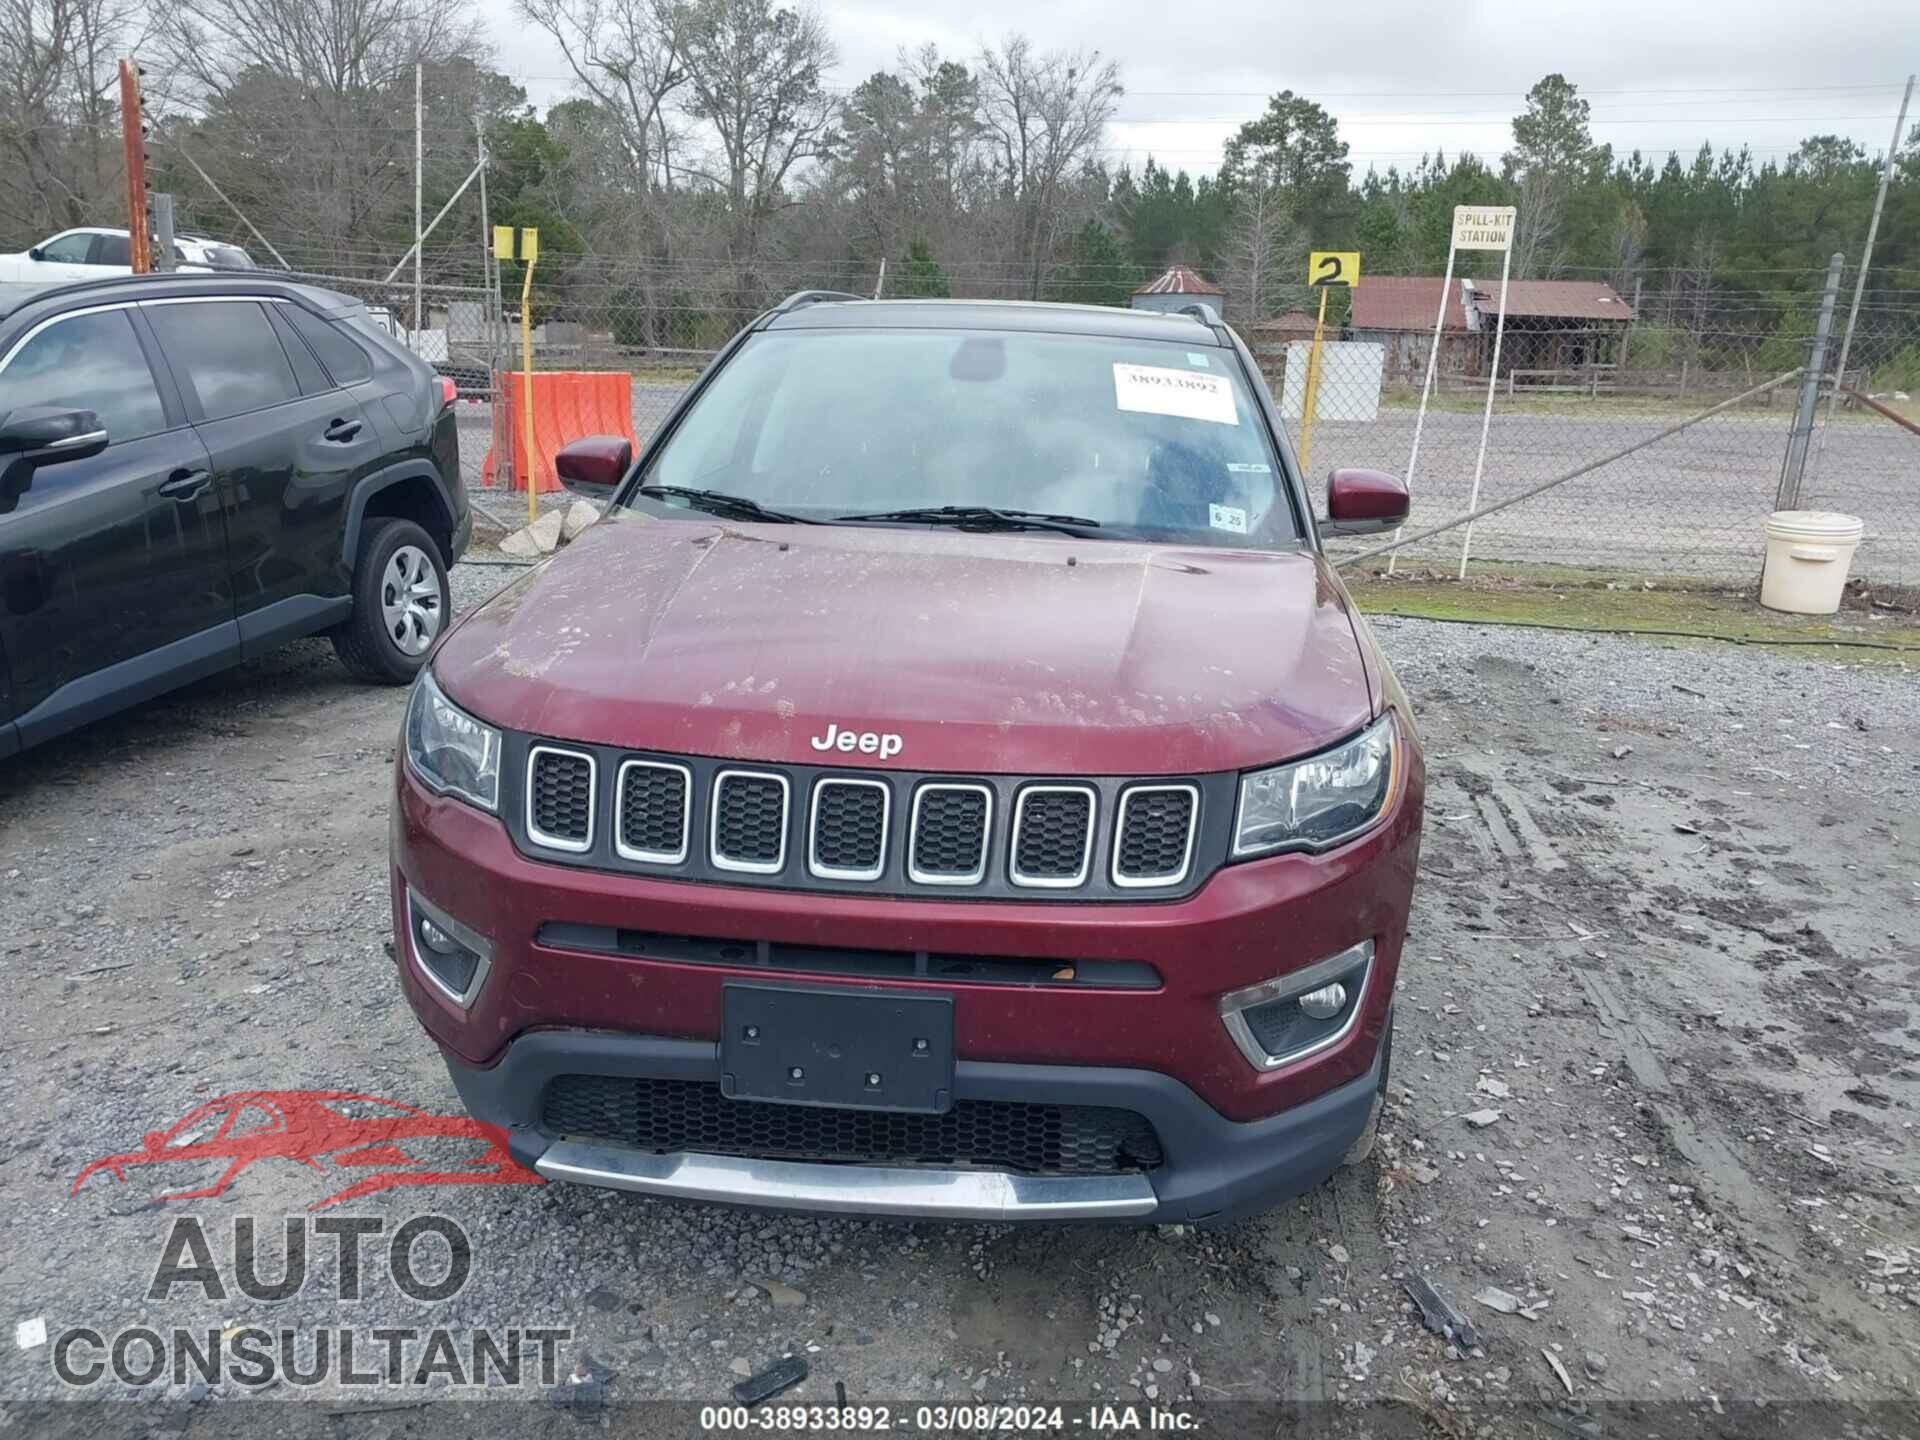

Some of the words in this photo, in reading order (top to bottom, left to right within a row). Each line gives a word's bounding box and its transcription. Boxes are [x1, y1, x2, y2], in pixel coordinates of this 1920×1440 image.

[1456, 213, 1513, 226] SPILL-KIT
[1458, 229, 1507, 243] STATION
[1312, 256, 1350, 286] 2
[811, 723, 903, 760] Jeep
